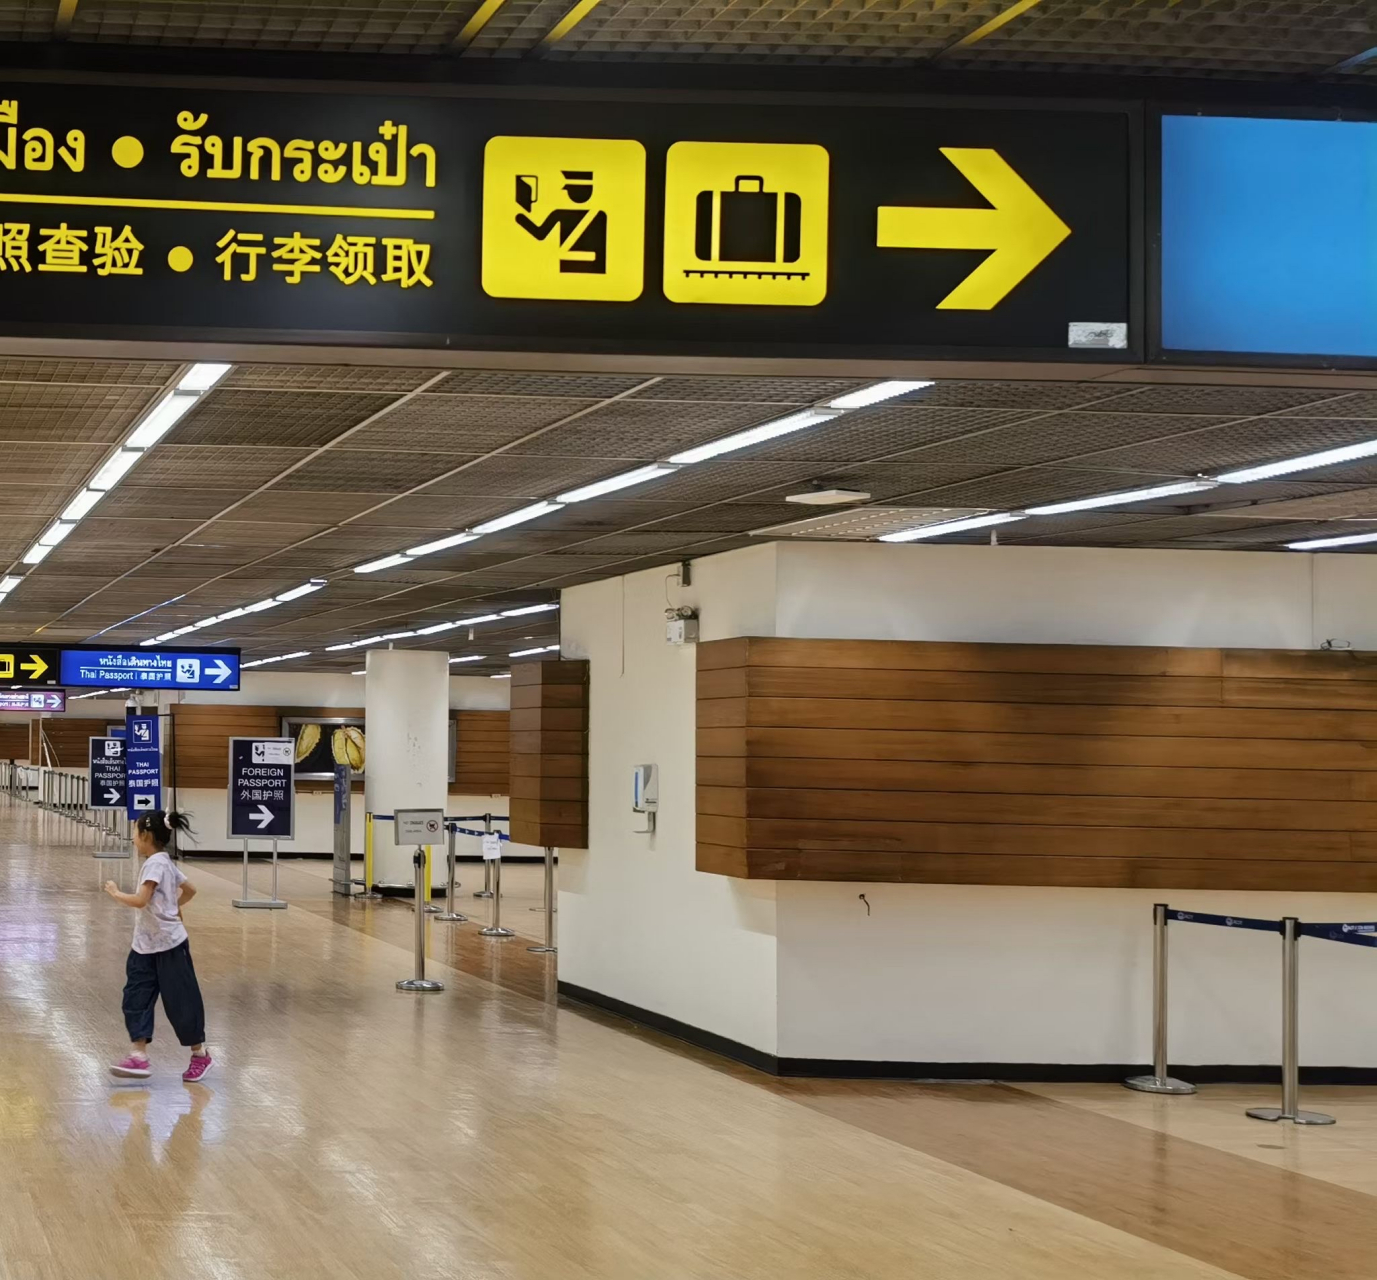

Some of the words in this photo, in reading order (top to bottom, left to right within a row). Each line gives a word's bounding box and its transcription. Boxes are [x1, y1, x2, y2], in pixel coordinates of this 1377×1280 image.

[170, 110, 436, 188] รับกระเป๋า
[215, 228, 434, 289] 行李领取
[80, 670, 97, 679] Thai
[99, 670, 134, 681] Passport
[242, 767, 284, 776] FOREIGN
[237, 778, 287, 788] PASSPORT
[240, 789, 284, 801] 外国护照
